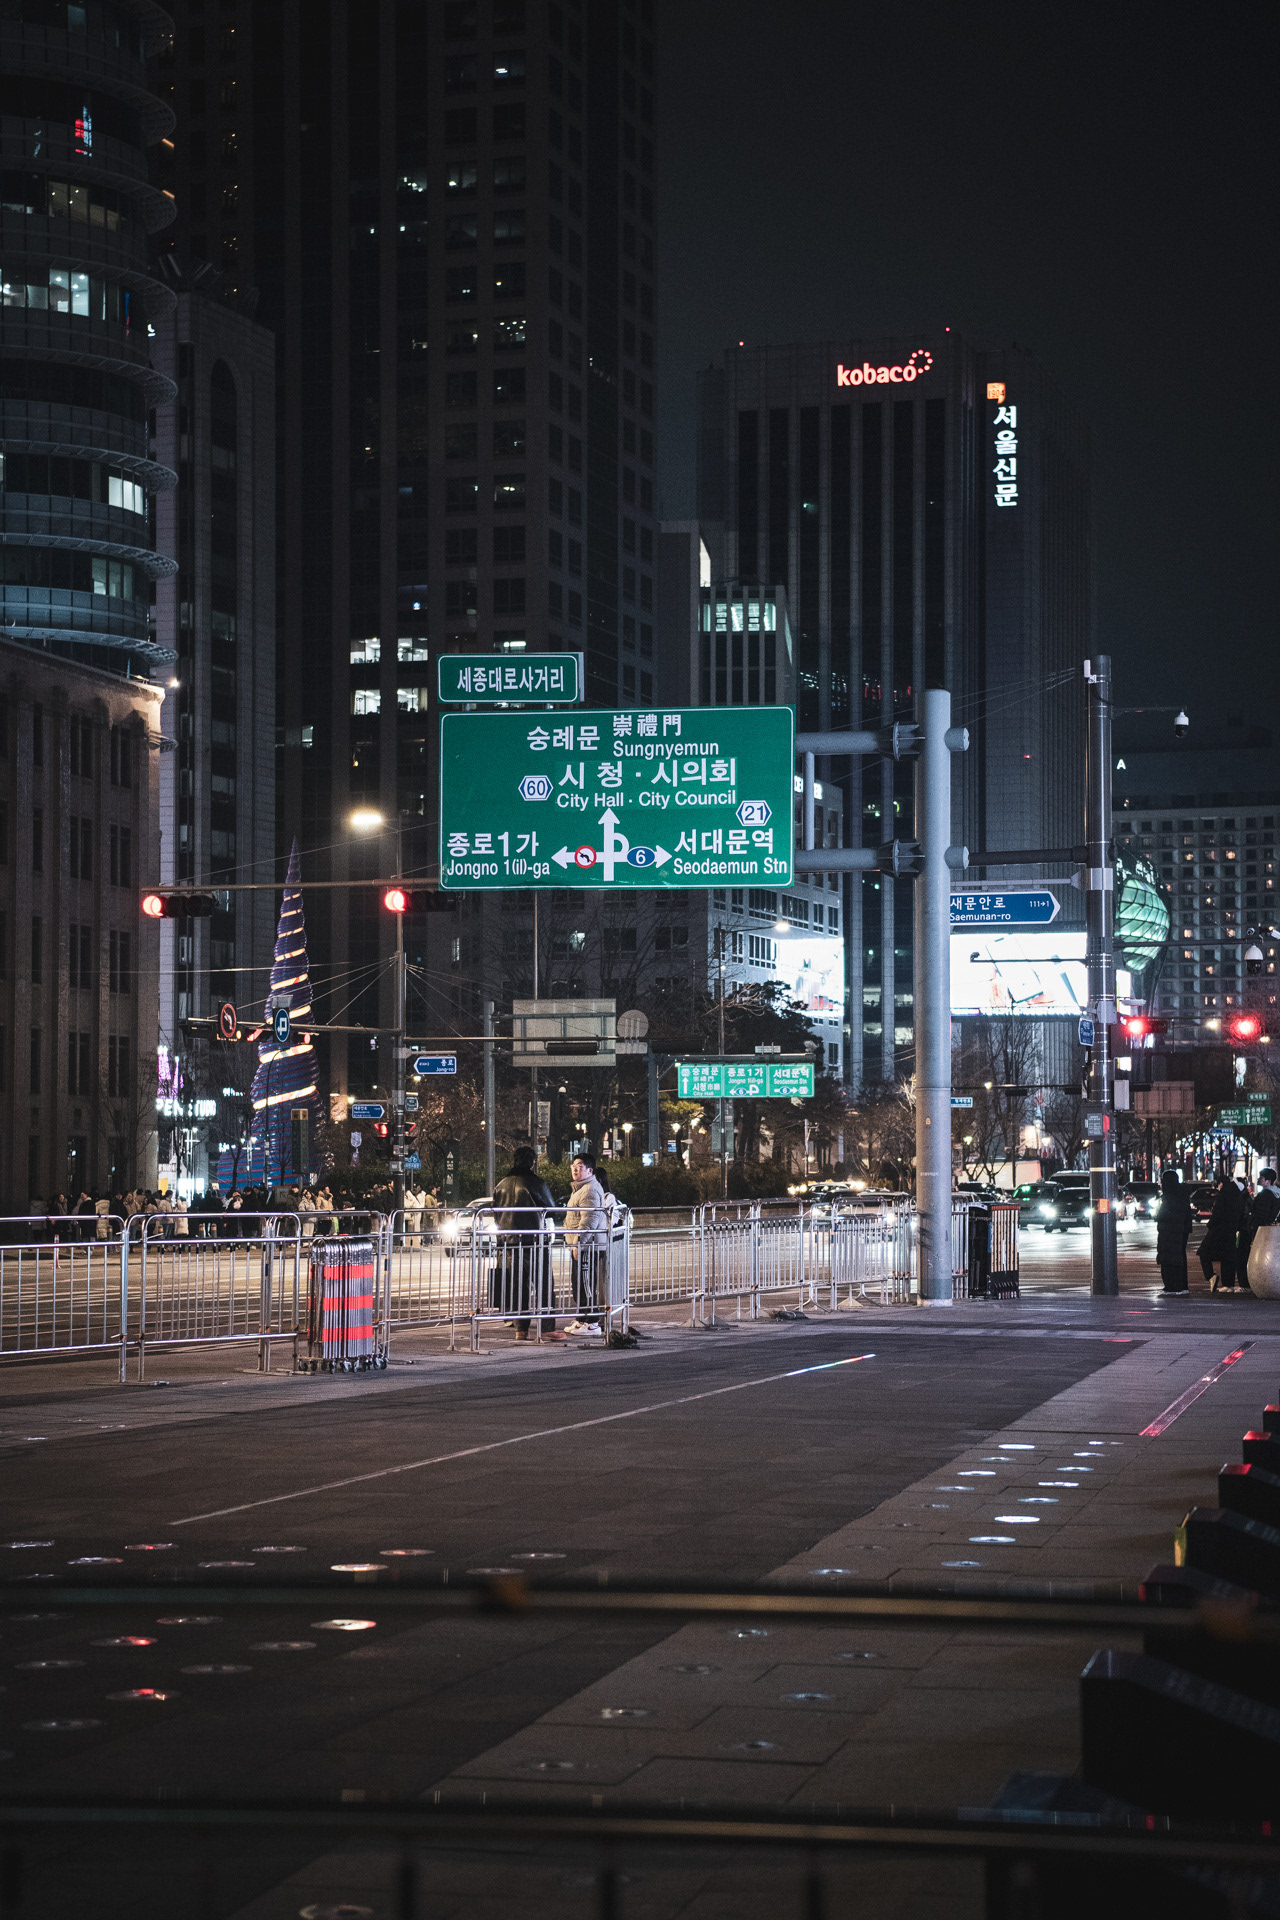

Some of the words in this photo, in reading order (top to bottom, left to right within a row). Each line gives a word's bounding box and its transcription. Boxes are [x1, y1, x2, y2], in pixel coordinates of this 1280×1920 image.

[837, 363, 917, 387] kobaco
[993, 405, 1018, 507] 서울신문
[457, 665, 565, 693] 세종대로사거리
[612, 714, 682, 737] 崇禮門
[526, 725, 601, 751] 숭례문
[612, 739, 720, 760] Sungnyemun
[651, 757, 737, 787] 시의회
[526, 779, 547, 797] 60
[556, 792, 591, 812] City
[593, 790, 625, 808] Hall
[638, 791, 670, 810] City
[675, 789, 737, 806] Council
[744, 805, 766, 822] 21
[446, 831, 540, 858] 종로1가
[673, 827, 775, 855] 서대문역
[446, 858, 499, 877] Jongno
[503, 857, 551, 879] 1(il)-ga
[635, 849, 647, 865] 6
[673, 858, 759, 876] Seodaemun
[763, 857, 788, 875] Stn
[950, 896, 1006, 910] 새문안로
[950, 913, 1012, 922] Saemunan-ro
[773, 1067, 810, 1079] 서대문역
